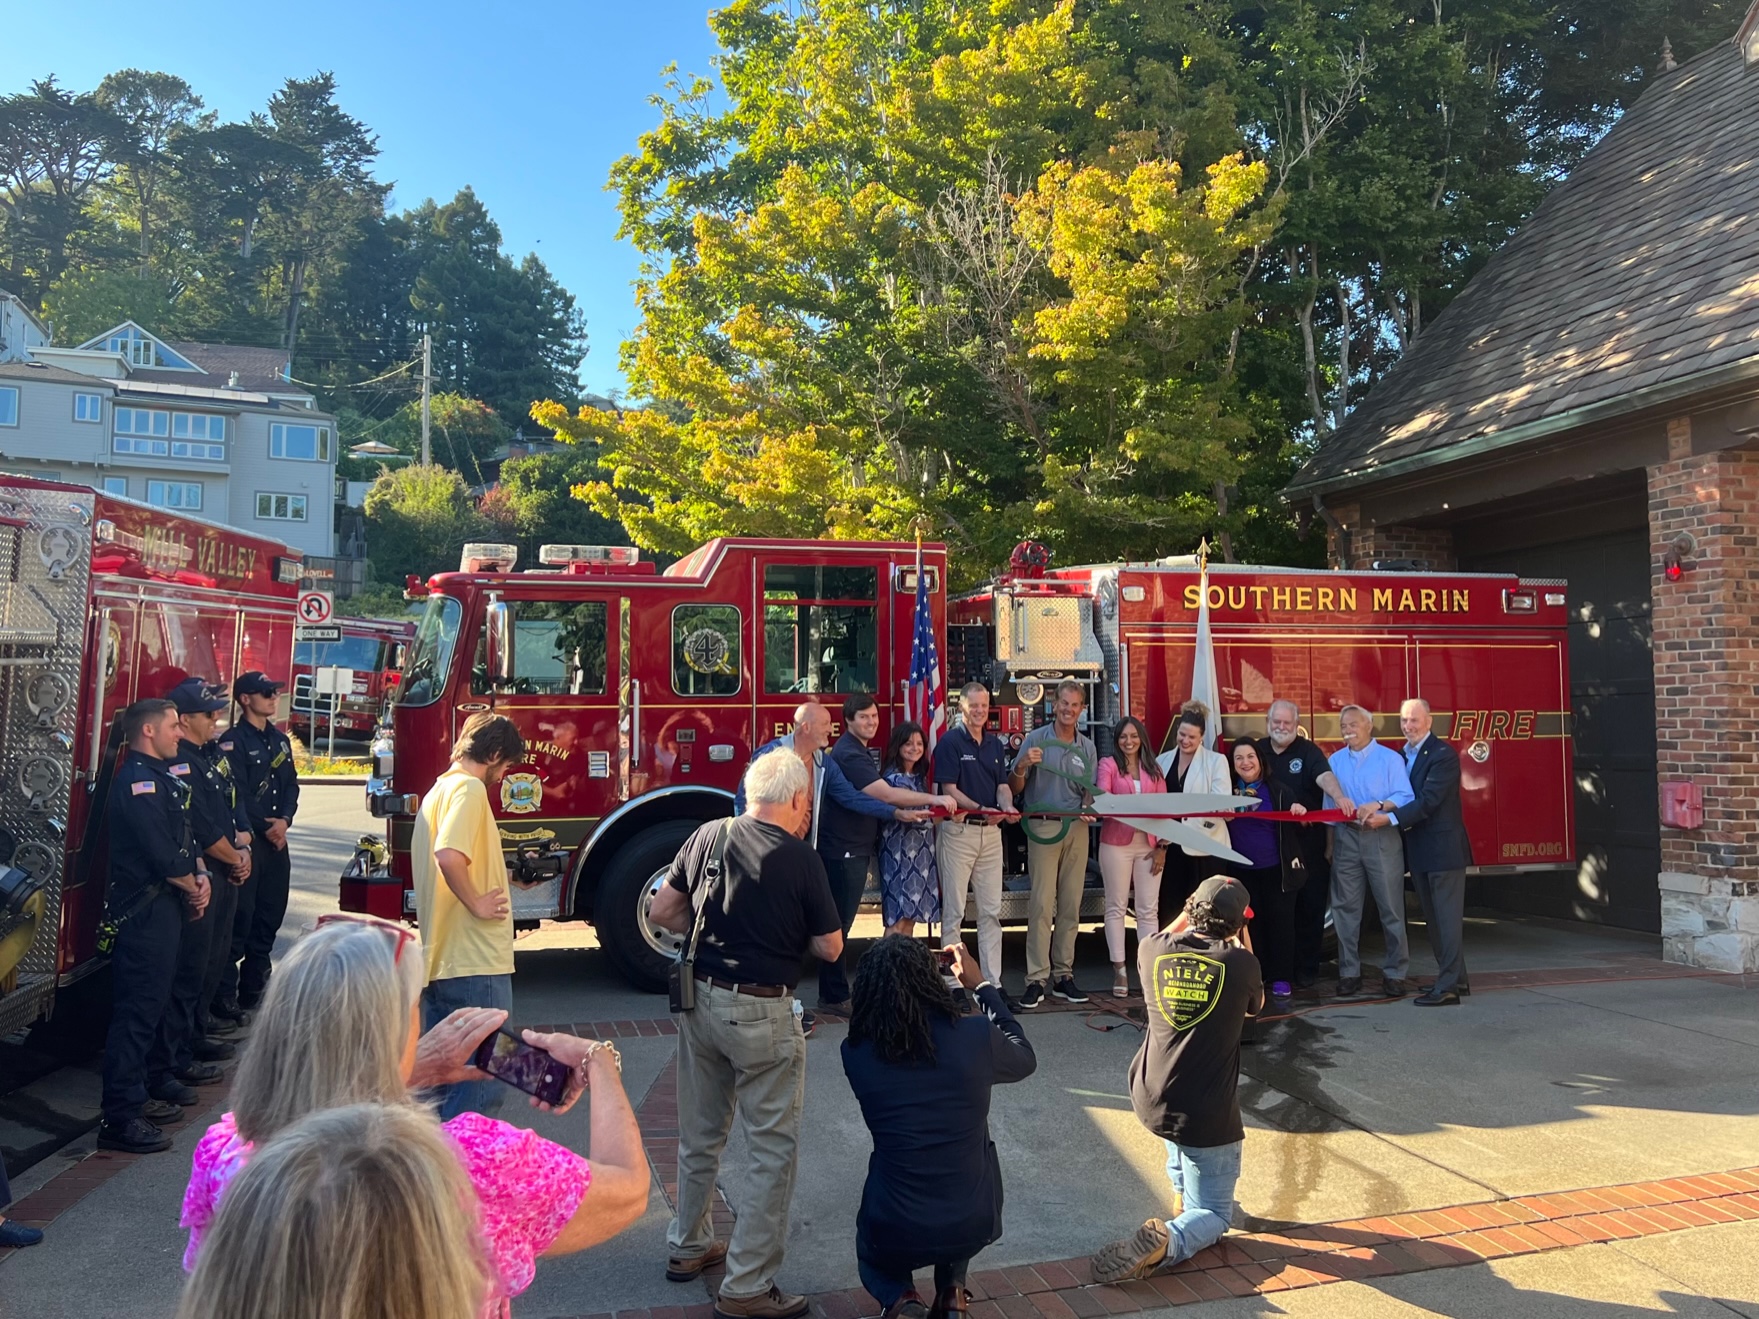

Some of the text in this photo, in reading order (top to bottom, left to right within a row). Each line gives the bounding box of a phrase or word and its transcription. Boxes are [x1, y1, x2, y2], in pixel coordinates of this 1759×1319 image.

[142, 525, 257, 580] MILL VALLEY
[1184, 585, 1470, 612] SOUTHERN MARIN
[1451, 710, 1535, 740] FIRE
[535, 740, 570, 761] MARIN
[1502, 842, 1563, 857] SMFD.ORG
[1167, 988, 1205, 999] WATCH
